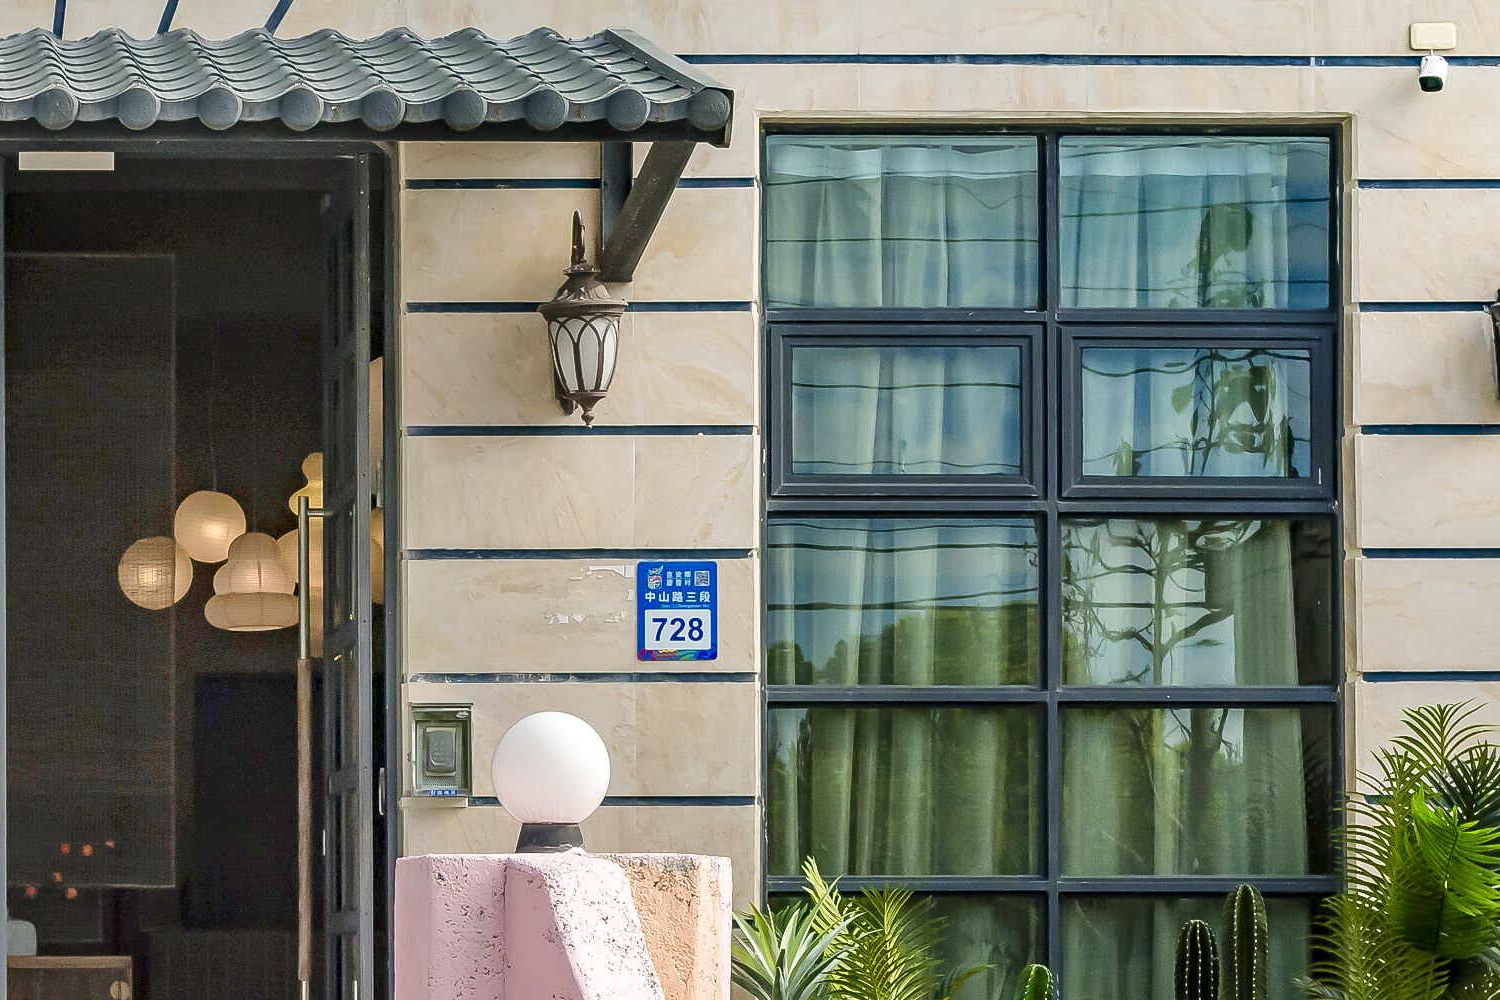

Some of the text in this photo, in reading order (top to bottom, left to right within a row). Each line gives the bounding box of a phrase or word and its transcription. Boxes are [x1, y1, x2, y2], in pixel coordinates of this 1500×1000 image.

[644, 591, 711, 603] 中山路三段
[651, 617, 704, 642] 728
